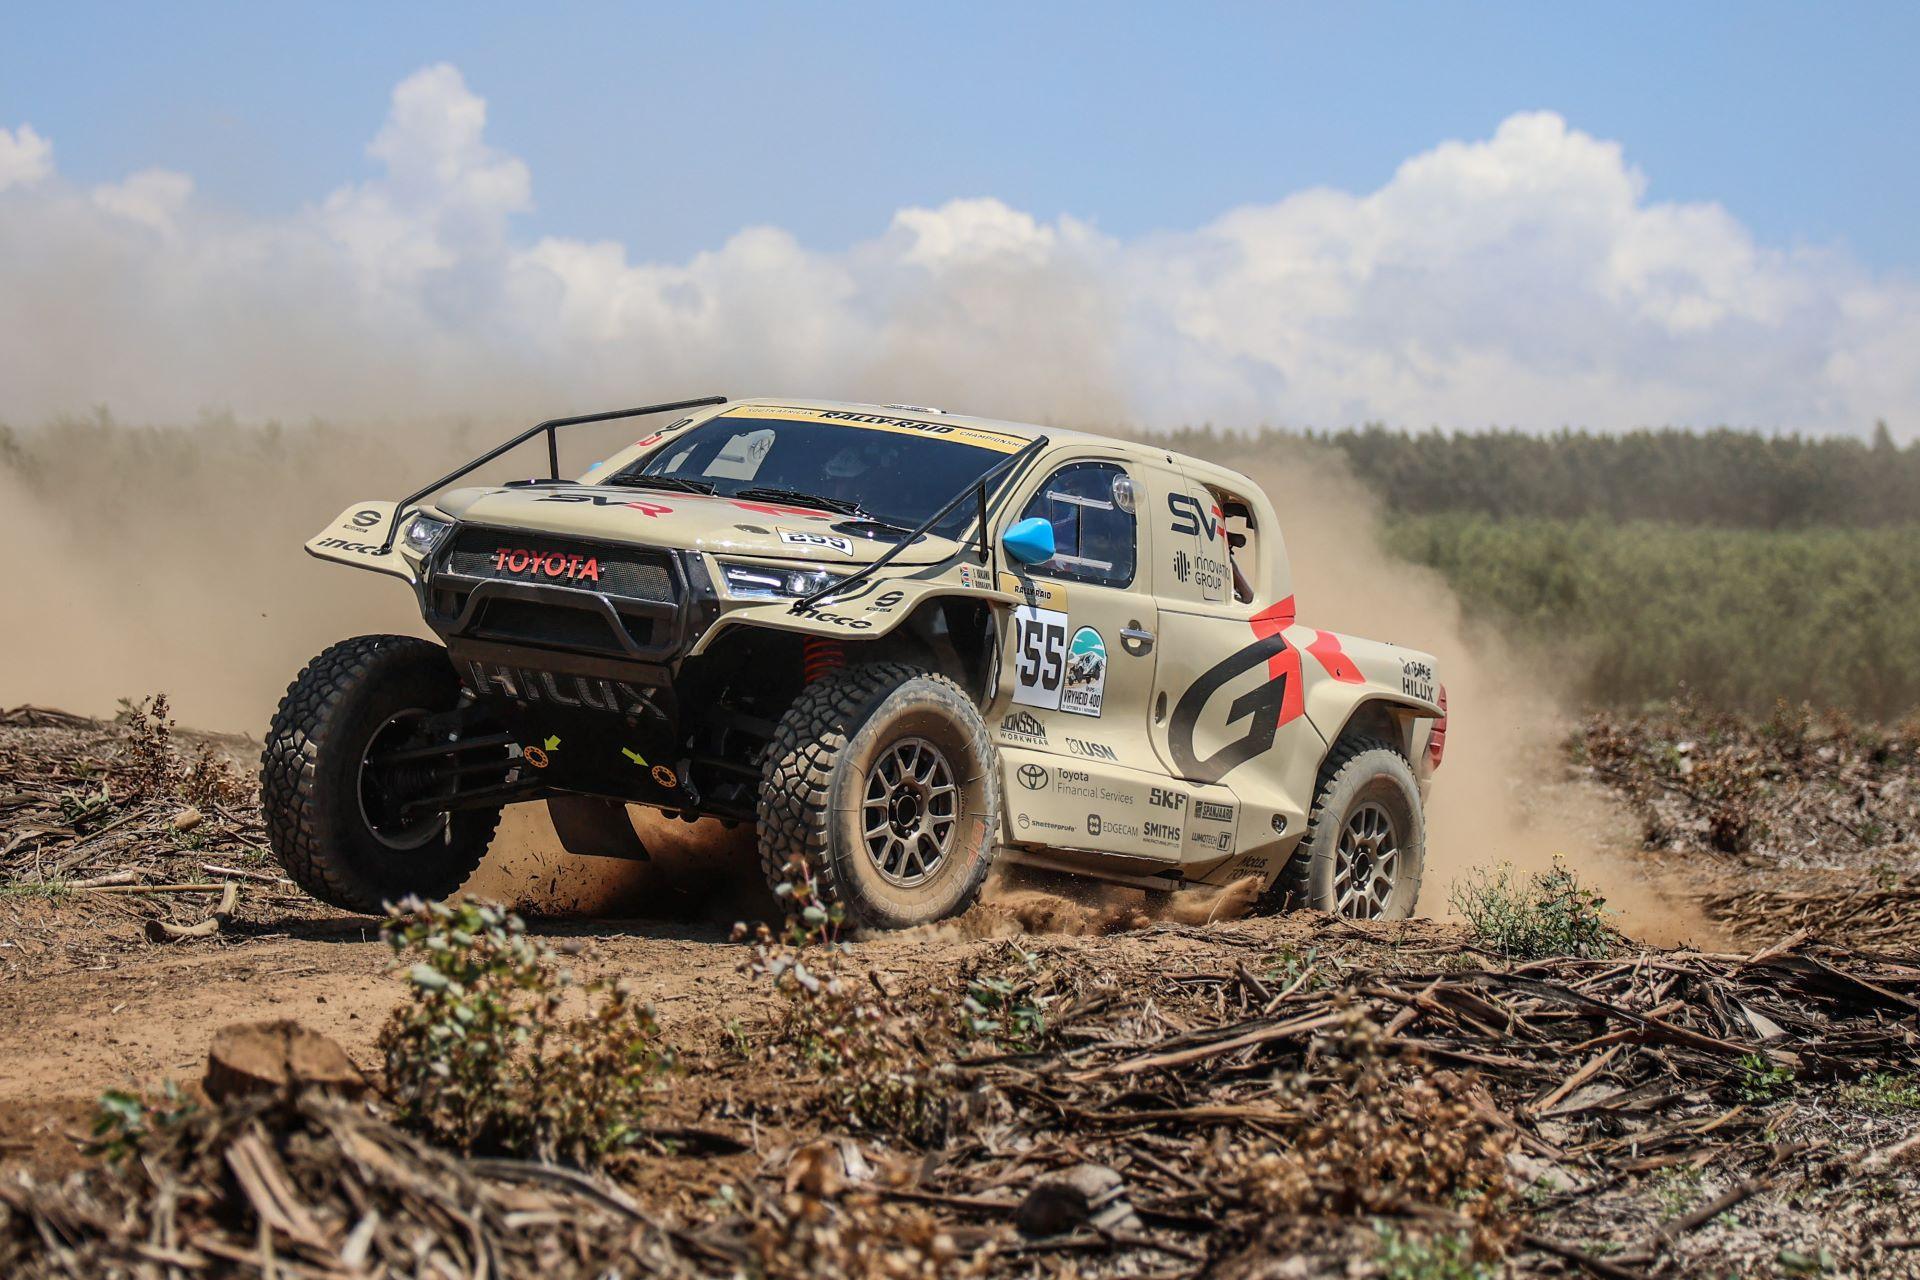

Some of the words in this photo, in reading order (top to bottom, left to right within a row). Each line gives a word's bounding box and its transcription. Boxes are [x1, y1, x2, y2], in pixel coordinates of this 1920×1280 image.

[495, 547, 599, 582] TOYOTA
[1194, 571, 1222, 590] GROUP
[469, 659, 669, 720] HILUX
[1063, 688, 1089, 706] VRYHEID
[1089, 693, 1101, 708] 400
[1402, 676, 1434, 704] HILUX
[1001, 710, 1046, 737] JONSSON
[1000, 731, 1049, 746] WORKWEAR
[1081, 741, 1118, 761] USN
[1057, 767, 1089, 782] Toyota
[1057, 782, 1098, 799] Financial
[1099, 787, 1134, 805] Services
[1149, 787, 1187, 811] SKF
[1102, 821, 1139, 837] EDGECAM
[1143, 821, 1181, 842] SMITHS
